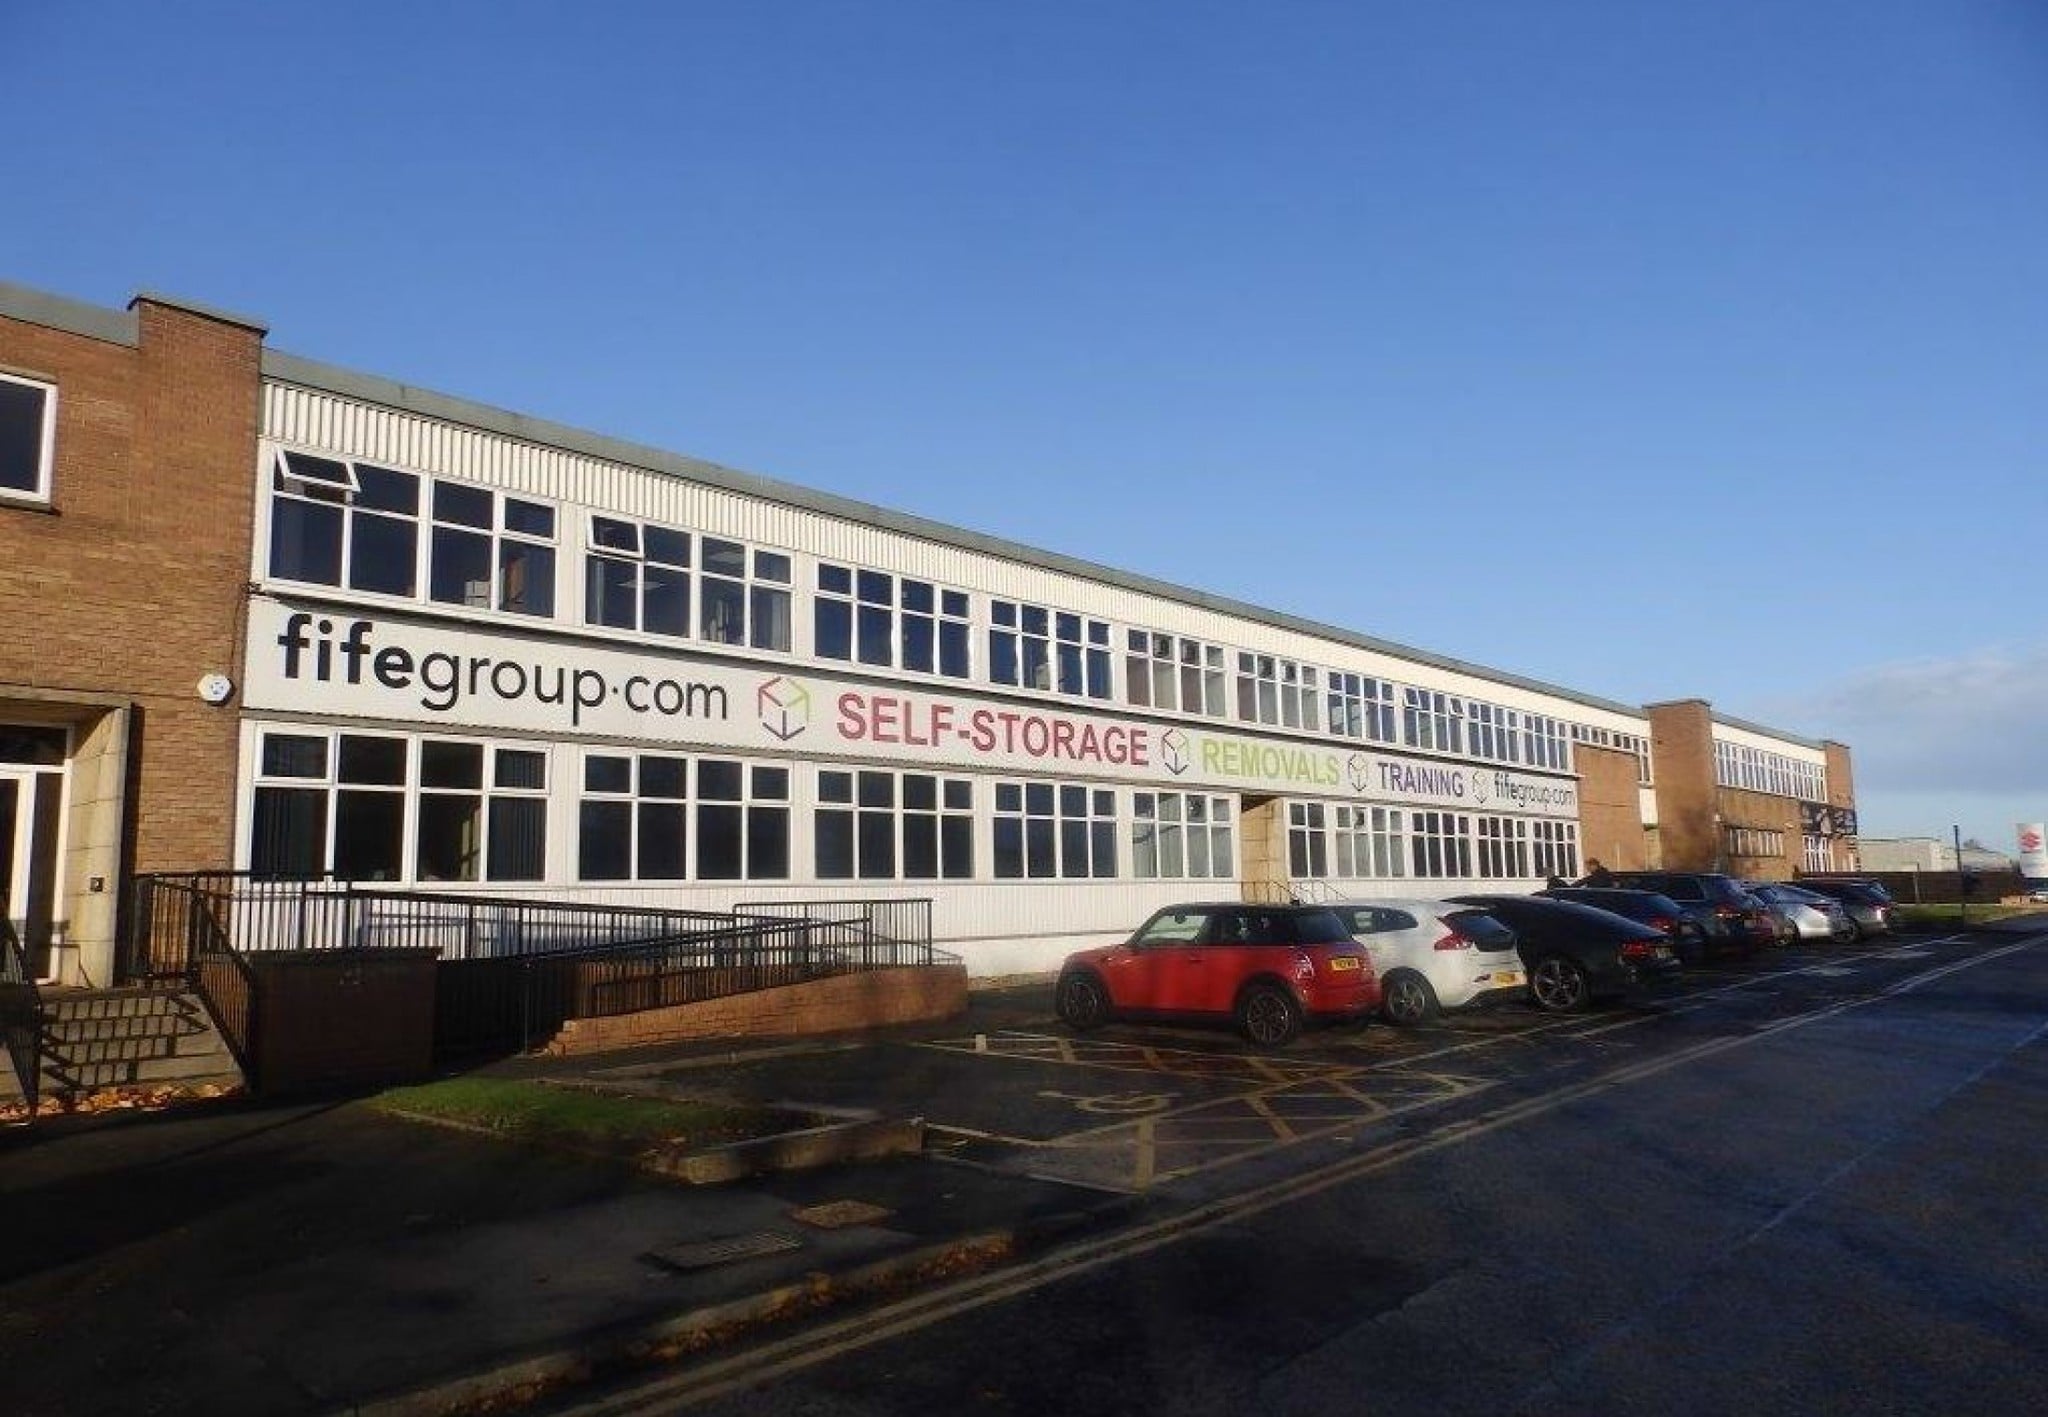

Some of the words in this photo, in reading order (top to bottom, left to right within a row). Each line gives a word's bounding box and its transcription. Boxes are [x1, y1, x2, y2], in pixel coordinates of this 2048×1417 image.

[836, 692, 1150, 766] SELF-STORAGE
[1201, 738, 1340, 786] REMOVALS
[1378, 761, 1465, 798] TRAINING
